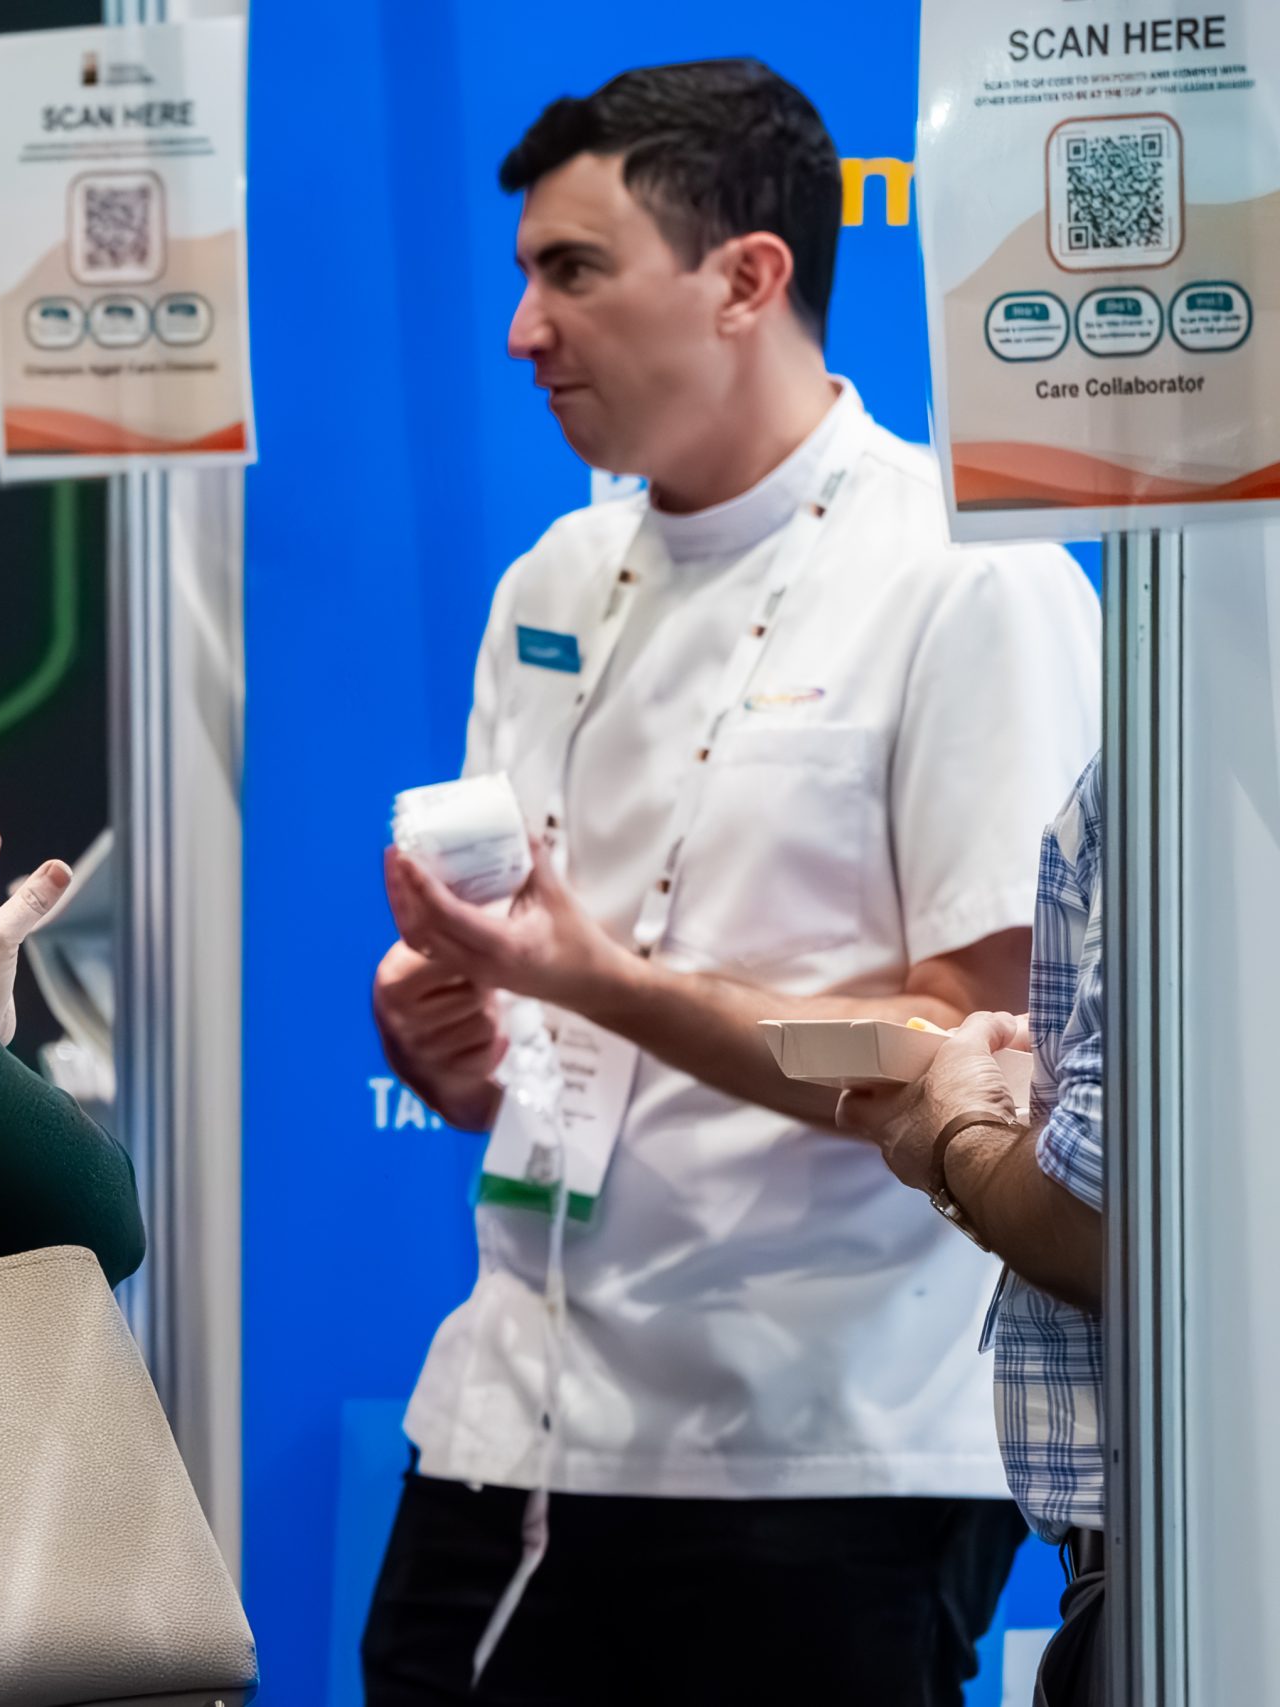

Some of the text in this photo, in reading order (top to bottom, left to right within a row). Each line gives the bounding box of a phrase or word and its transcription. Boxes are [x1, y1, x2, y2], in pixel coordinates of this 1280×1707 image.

[1009, 14, 1226, 61] SCAN HERE
[42, 98, 196, 133] SCAN HERE
[1035, 373, 1206, 399] Care Collaborator
[368, 1077, 441, 1130] TA
